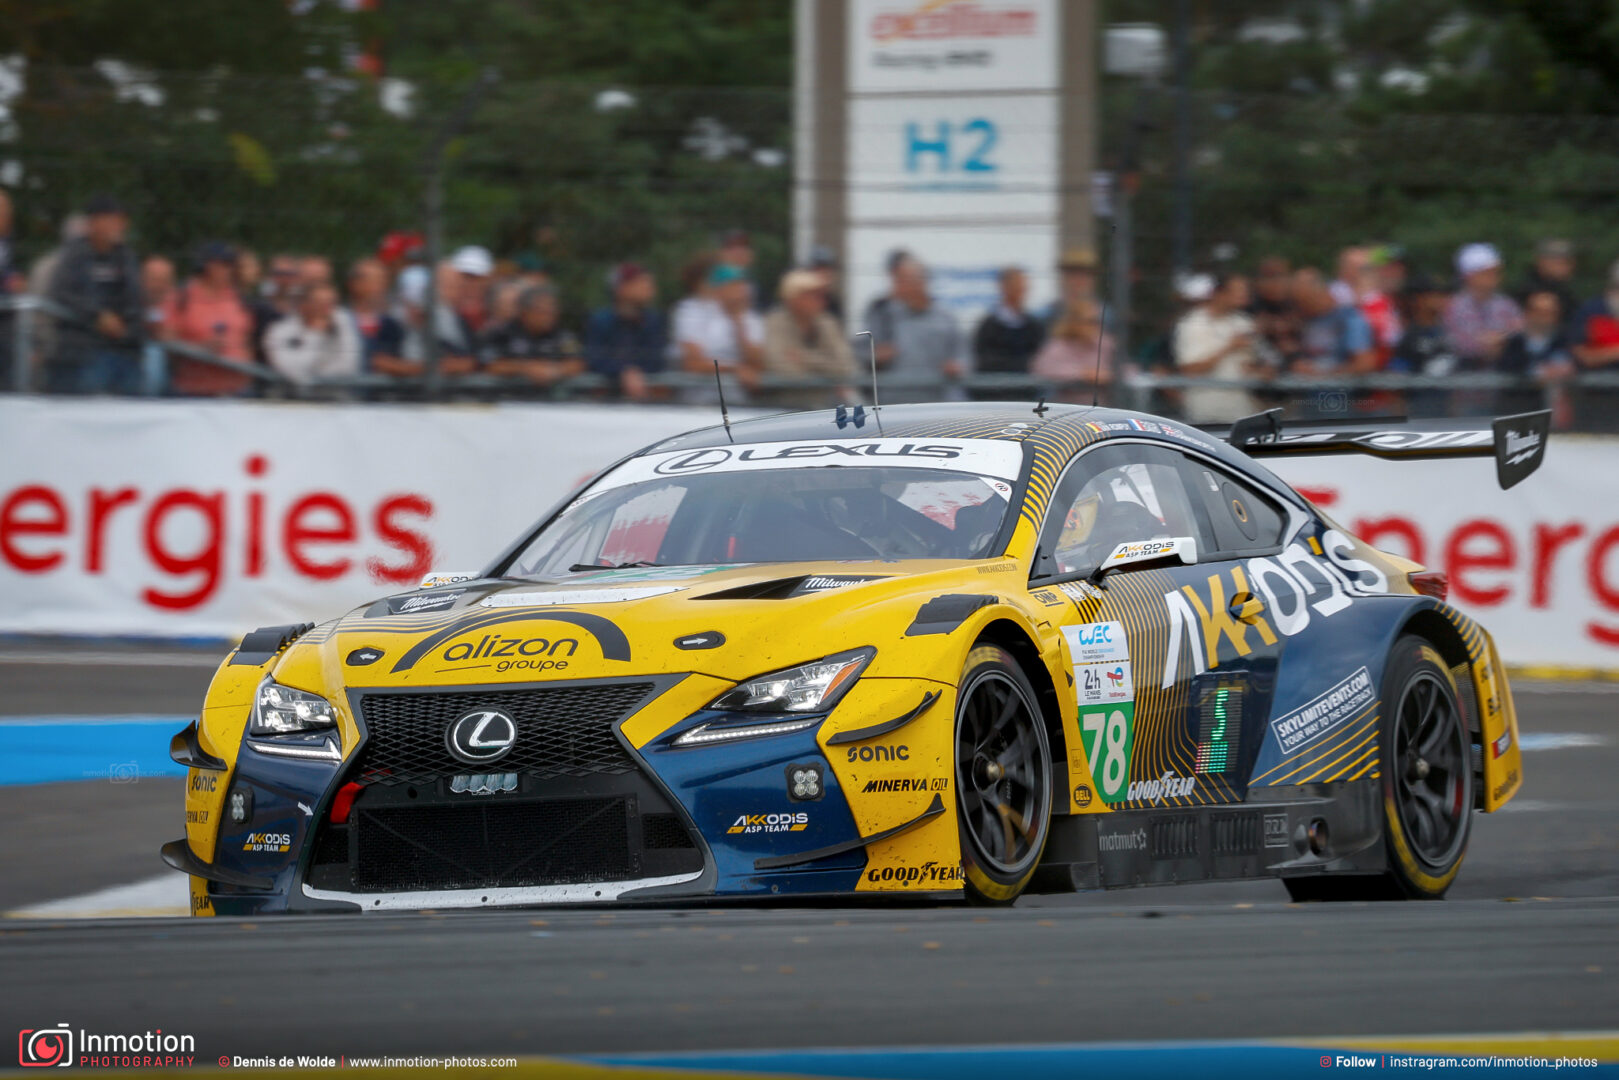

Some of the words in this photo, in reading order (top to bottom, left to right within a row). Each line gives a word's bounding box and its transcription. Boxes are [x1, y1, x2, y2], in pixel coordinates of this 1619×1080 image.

[904, 119, 998, 173] H2
[739, 443, 963, 461] LEXUS
[0, 454, 435, 614] ergies
[1294, 486, 1619, 647] ner
[1079, 625, 1112, 645] WEC
[443, 634, 579, 661] alizon
[496, 659, 569, 673] groupe
[1277, 672, 1370, 738] SKYLIMITEVENTS.COM
[1283, 730, 1306, 747] YOUR
[1303, 721, 1320, 737] WAY
[1319, 716, 1330, 728] TO
[1328, 708, 1342, 722] THE
[1083, 710, 1127, 796] 78
[861, 778, 928, 793] MINERVA
[931, 778, 948, 791] OIL
[1075, 790, 1090, 801] BELL
[744, 825, 762, 834] ASP
[764, 823, 790, 833] TEAM
[252, 844, 264, 852] ASP
[264, 844, 279, 852] TEAM
[1099, 832, 1138, 851] matmut
